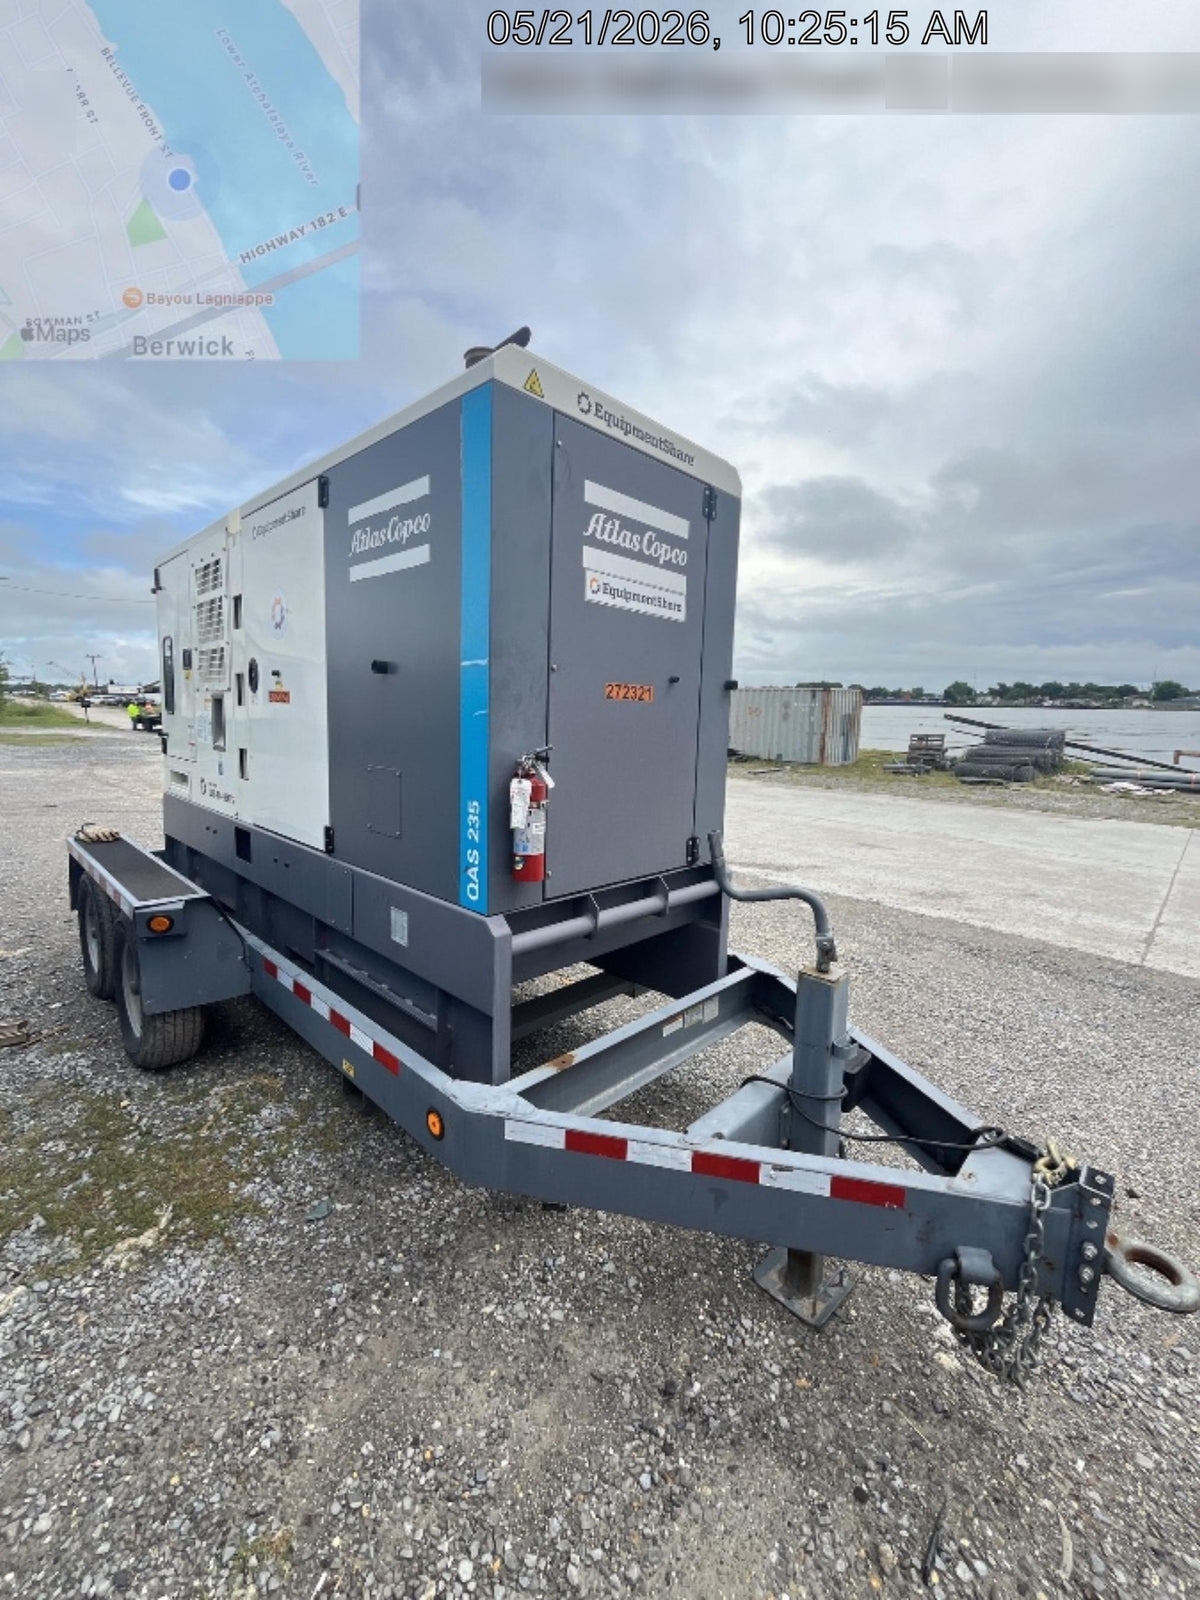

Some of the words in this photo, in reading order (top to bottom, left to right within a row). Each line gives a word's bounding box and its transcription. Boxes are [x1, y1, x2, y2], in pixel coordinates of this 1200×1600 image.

[593, 401, 695, 467] EquipmentShare
[348, 526, 387, 557] Atlas
[387, 512, 431, 545] Copco
[583, 513, 641, 552] Atlas
[642, 530, 688, 566] Copco
[606, 683, 653, 701] 272321
[468, 800, 481, 843] 235
[466, 850, 480, 901] QAS
